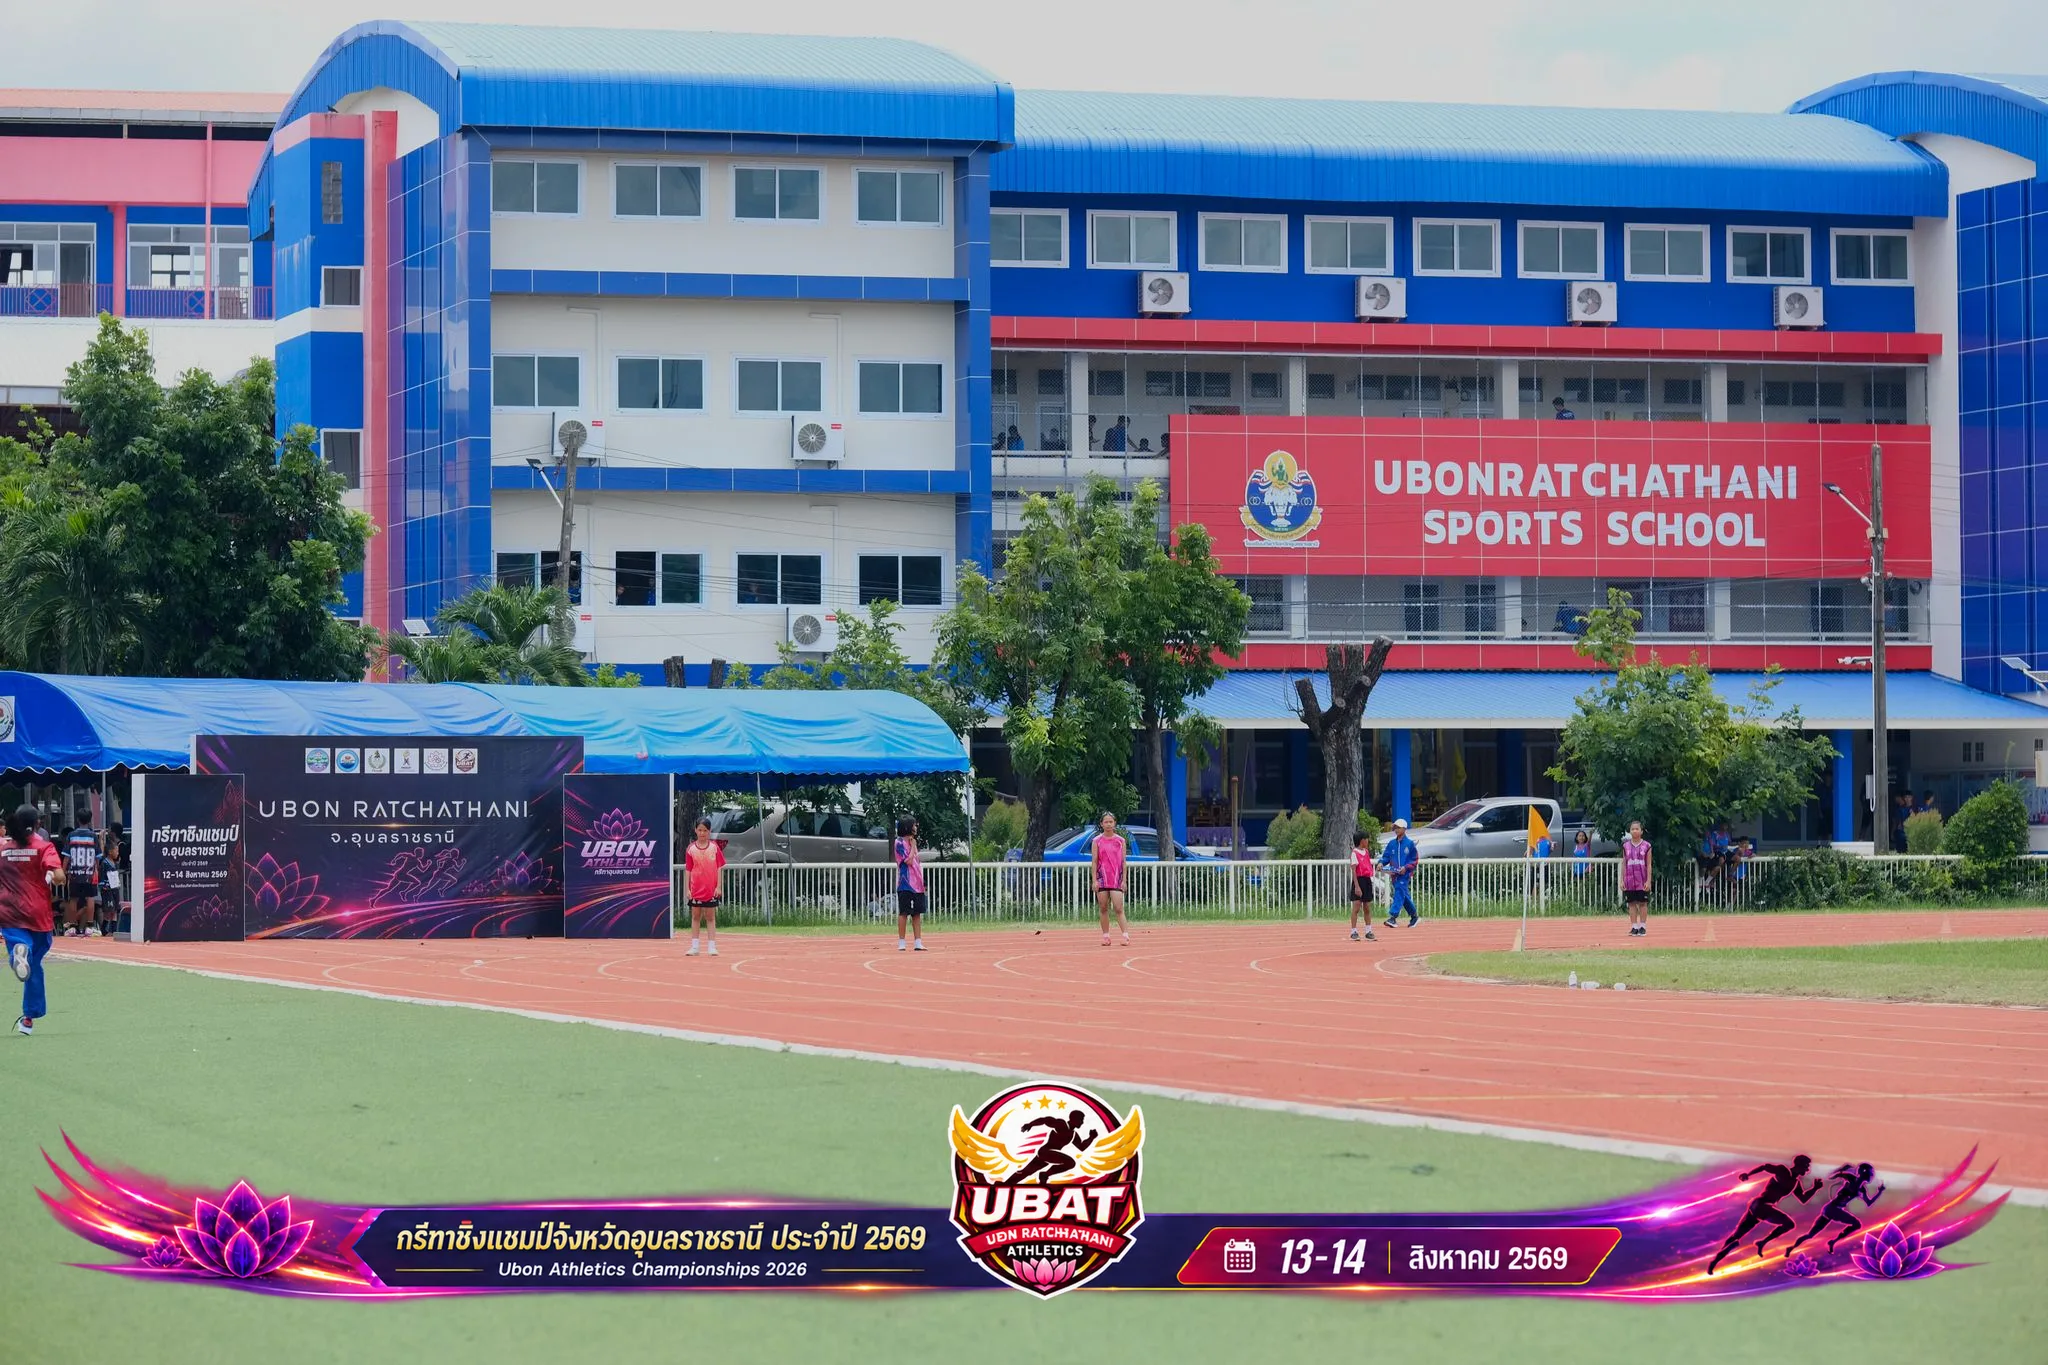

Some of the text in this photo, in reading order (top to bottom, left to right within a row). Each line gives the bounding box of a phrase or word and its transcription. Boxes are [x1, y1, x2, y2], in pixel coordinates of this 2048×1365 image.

[1373, 460, 1798, 500] UBONRATCHATHANI
[1423, 509, 1767, 548] SPORTS SCHOOL
[259, 800, 529, 818] UBON RATCHATHANI
[151, 824, 239, 843] กรีฑาชิงแชมป์
[330, 829, 455, 848] จ.อุบลราชธานี
[162, 844, 227, 859] จ.อุบลราชธานี
[581, 841, 656, 858] UBON
[582, 857, 653, 868] ATHLETICS
[185, 870, 209, 879] สิงหาคม
[211, 870, 228, 878] 2569
